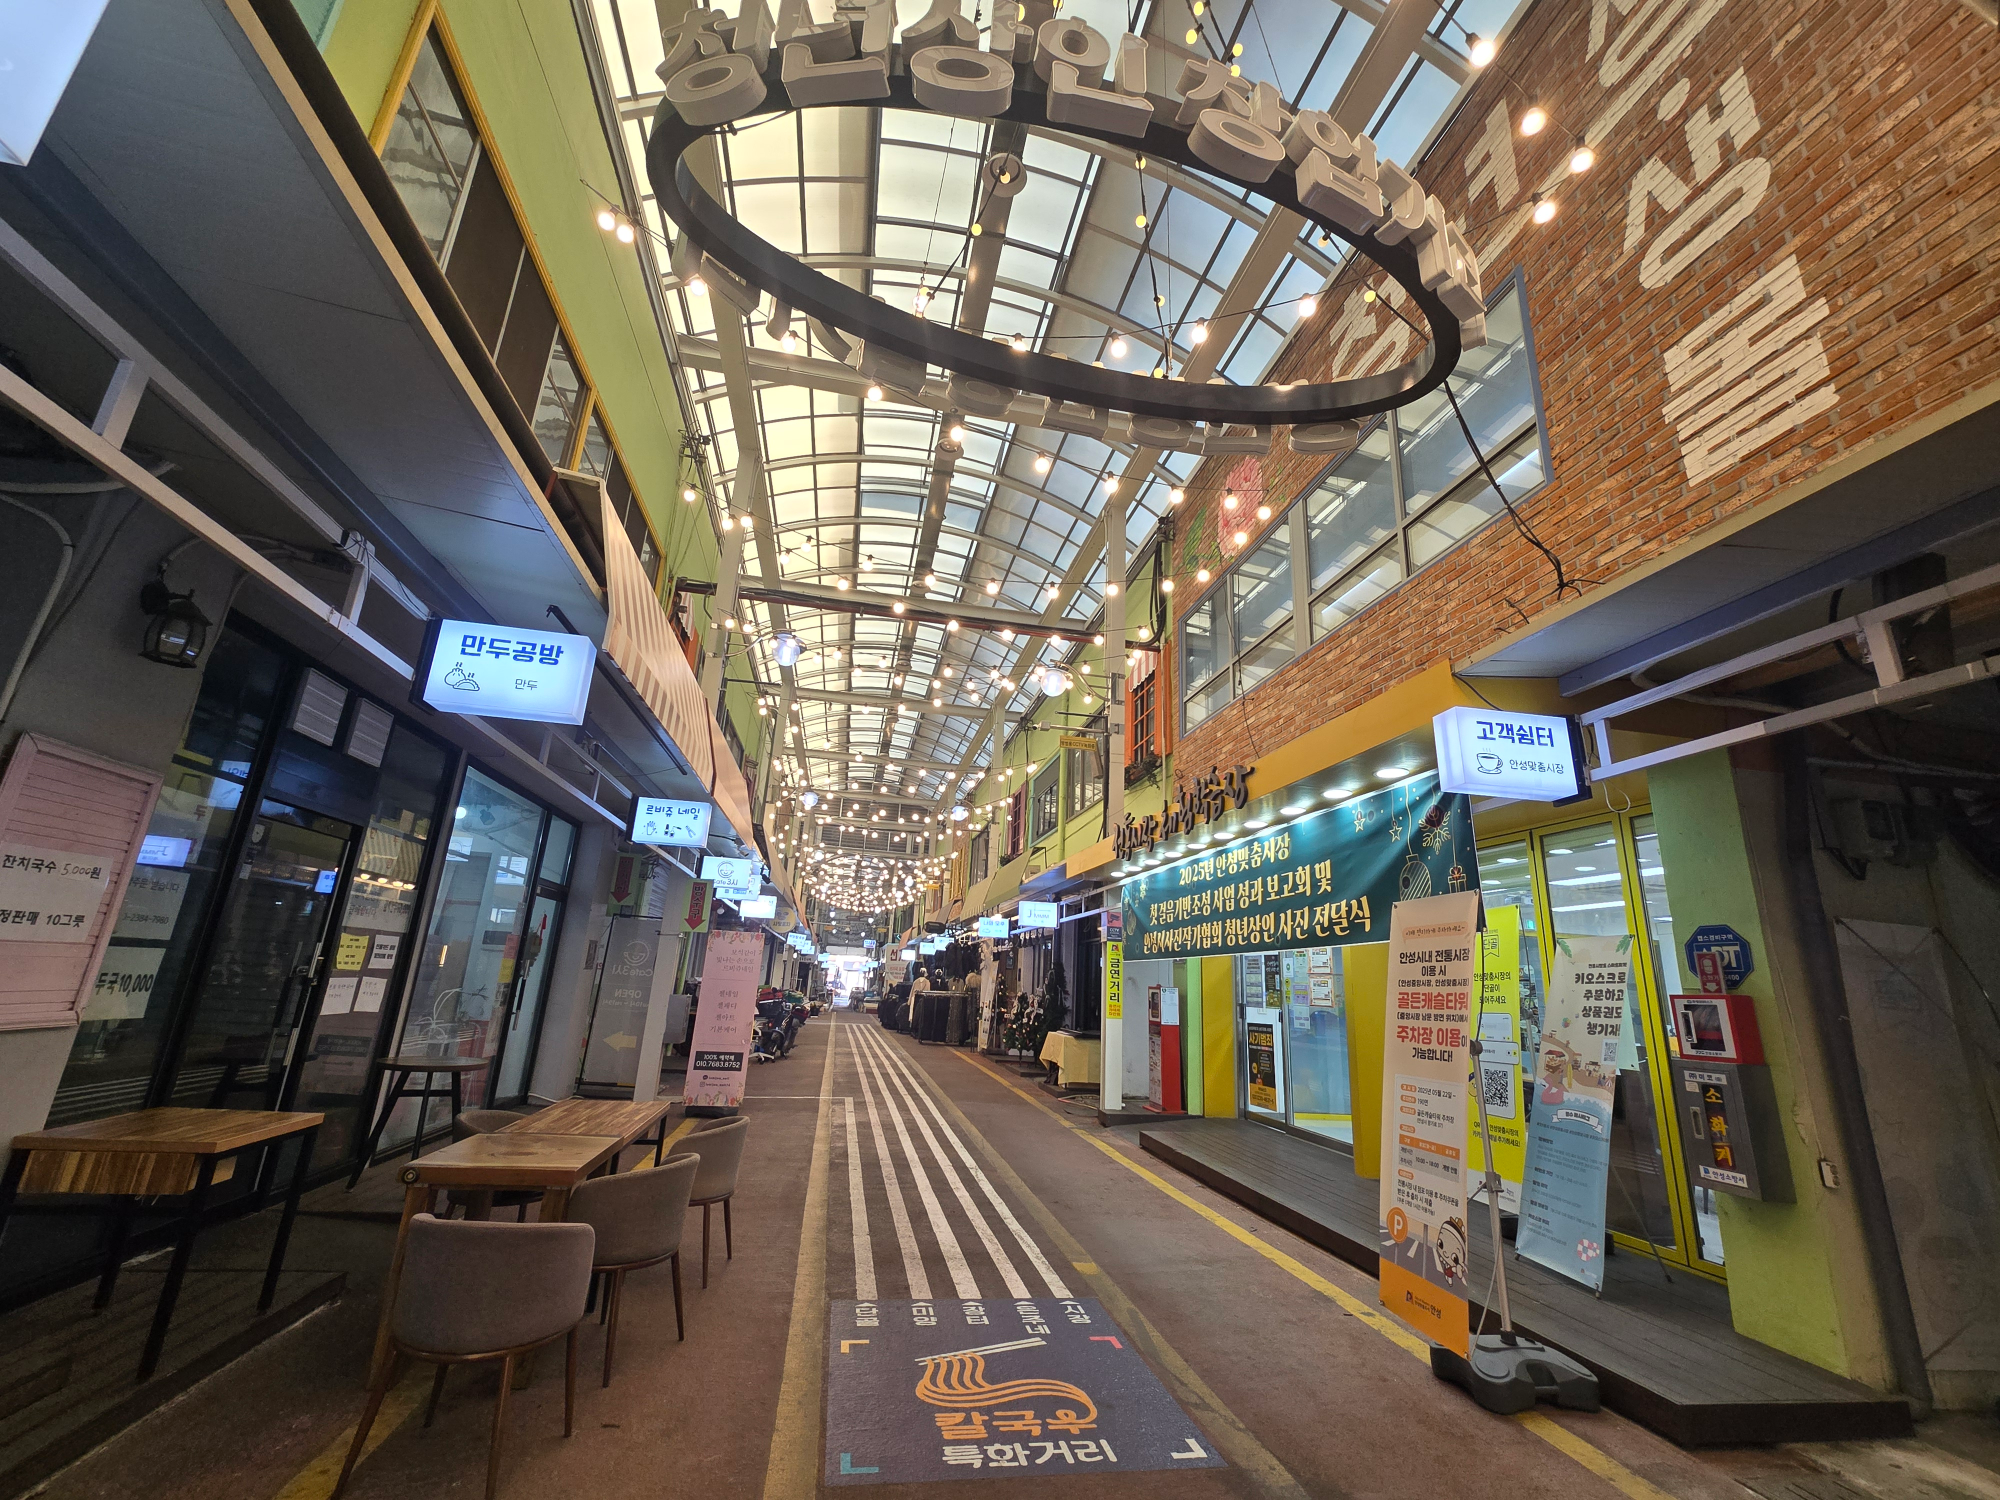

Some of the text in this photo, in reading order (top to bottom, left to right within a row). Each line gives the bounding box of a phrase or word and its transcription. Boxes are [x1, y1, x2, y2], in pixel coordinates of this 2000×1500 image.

[460, 634, 564, 665] 만두공방
[514, 678, 538, 690] 만두
[1476, 720, 1554, 748] 고객쉼터
[1509, 759, 1564, 774] 안성맞춤시장
[645, 804, 701, 820] 르비쥬 네일
[2, 854, 57, 874] 잔치국수
[1179, 832, 1291, 886] 2025년 안성맞춤시장
[149, 879, 180, 893] 받습니다
[1213, 886, 1235, 912] 사업
[1236, 881, 1263, 907] 성과
[1265, 867, 1312, 899] 보고회
[1313, 859, 1332, 895] 및
[689, 885, 706, 919] 방수구
[0, 909, 85, 928] 정판매 10그릇
[1144, 895, 1371, 954] 안성시사진작가협회 청년상인 사진 전달식
[1399, 948, 1471, 964] 안성시내 전통시장
[1110, 958, 1121, 1003] 금연거리
[1421, 964, 1447, 977] 이용 시
[1574, 971, 1627, 985] 키오스크로
[1397, 991, 1469, 1011] 골든캐슬타워
[1583, 988, 1624, 1002] 주문하고
[1581, 1005, 1622, 1019] 상품권도
[1249, 1031, 1273, 1046] 사기범죄
[1396, 1025, 1468, 1048] 주차장 이용이
[1412, 1047, 1454, 1063] 가능합니다!
[1418, 1086, 1432, 1095] 2025년
[1432, 1089, 1442, 1097] 05월
[1442, 1091, 1452, 1099] 22일
[1704, 1087, 1733, 1167] 소화기
[1397, 1179, 1413, 1190] 전통시장
[1712, 1170, 1745, 1184] 안성소방서
[1394, 1214, 1403, 1235] P
[855, 1306, 880, 1328] 단골
[911, 1306, 938, 1326] 미양
[962, 1305, 990, 1326] 장터
[1064, 1304, 1092, 1325] 시장
[1430, 1304, 1442, 1319] 안성
[941, 1439, 1119, 1469] 특화거리
